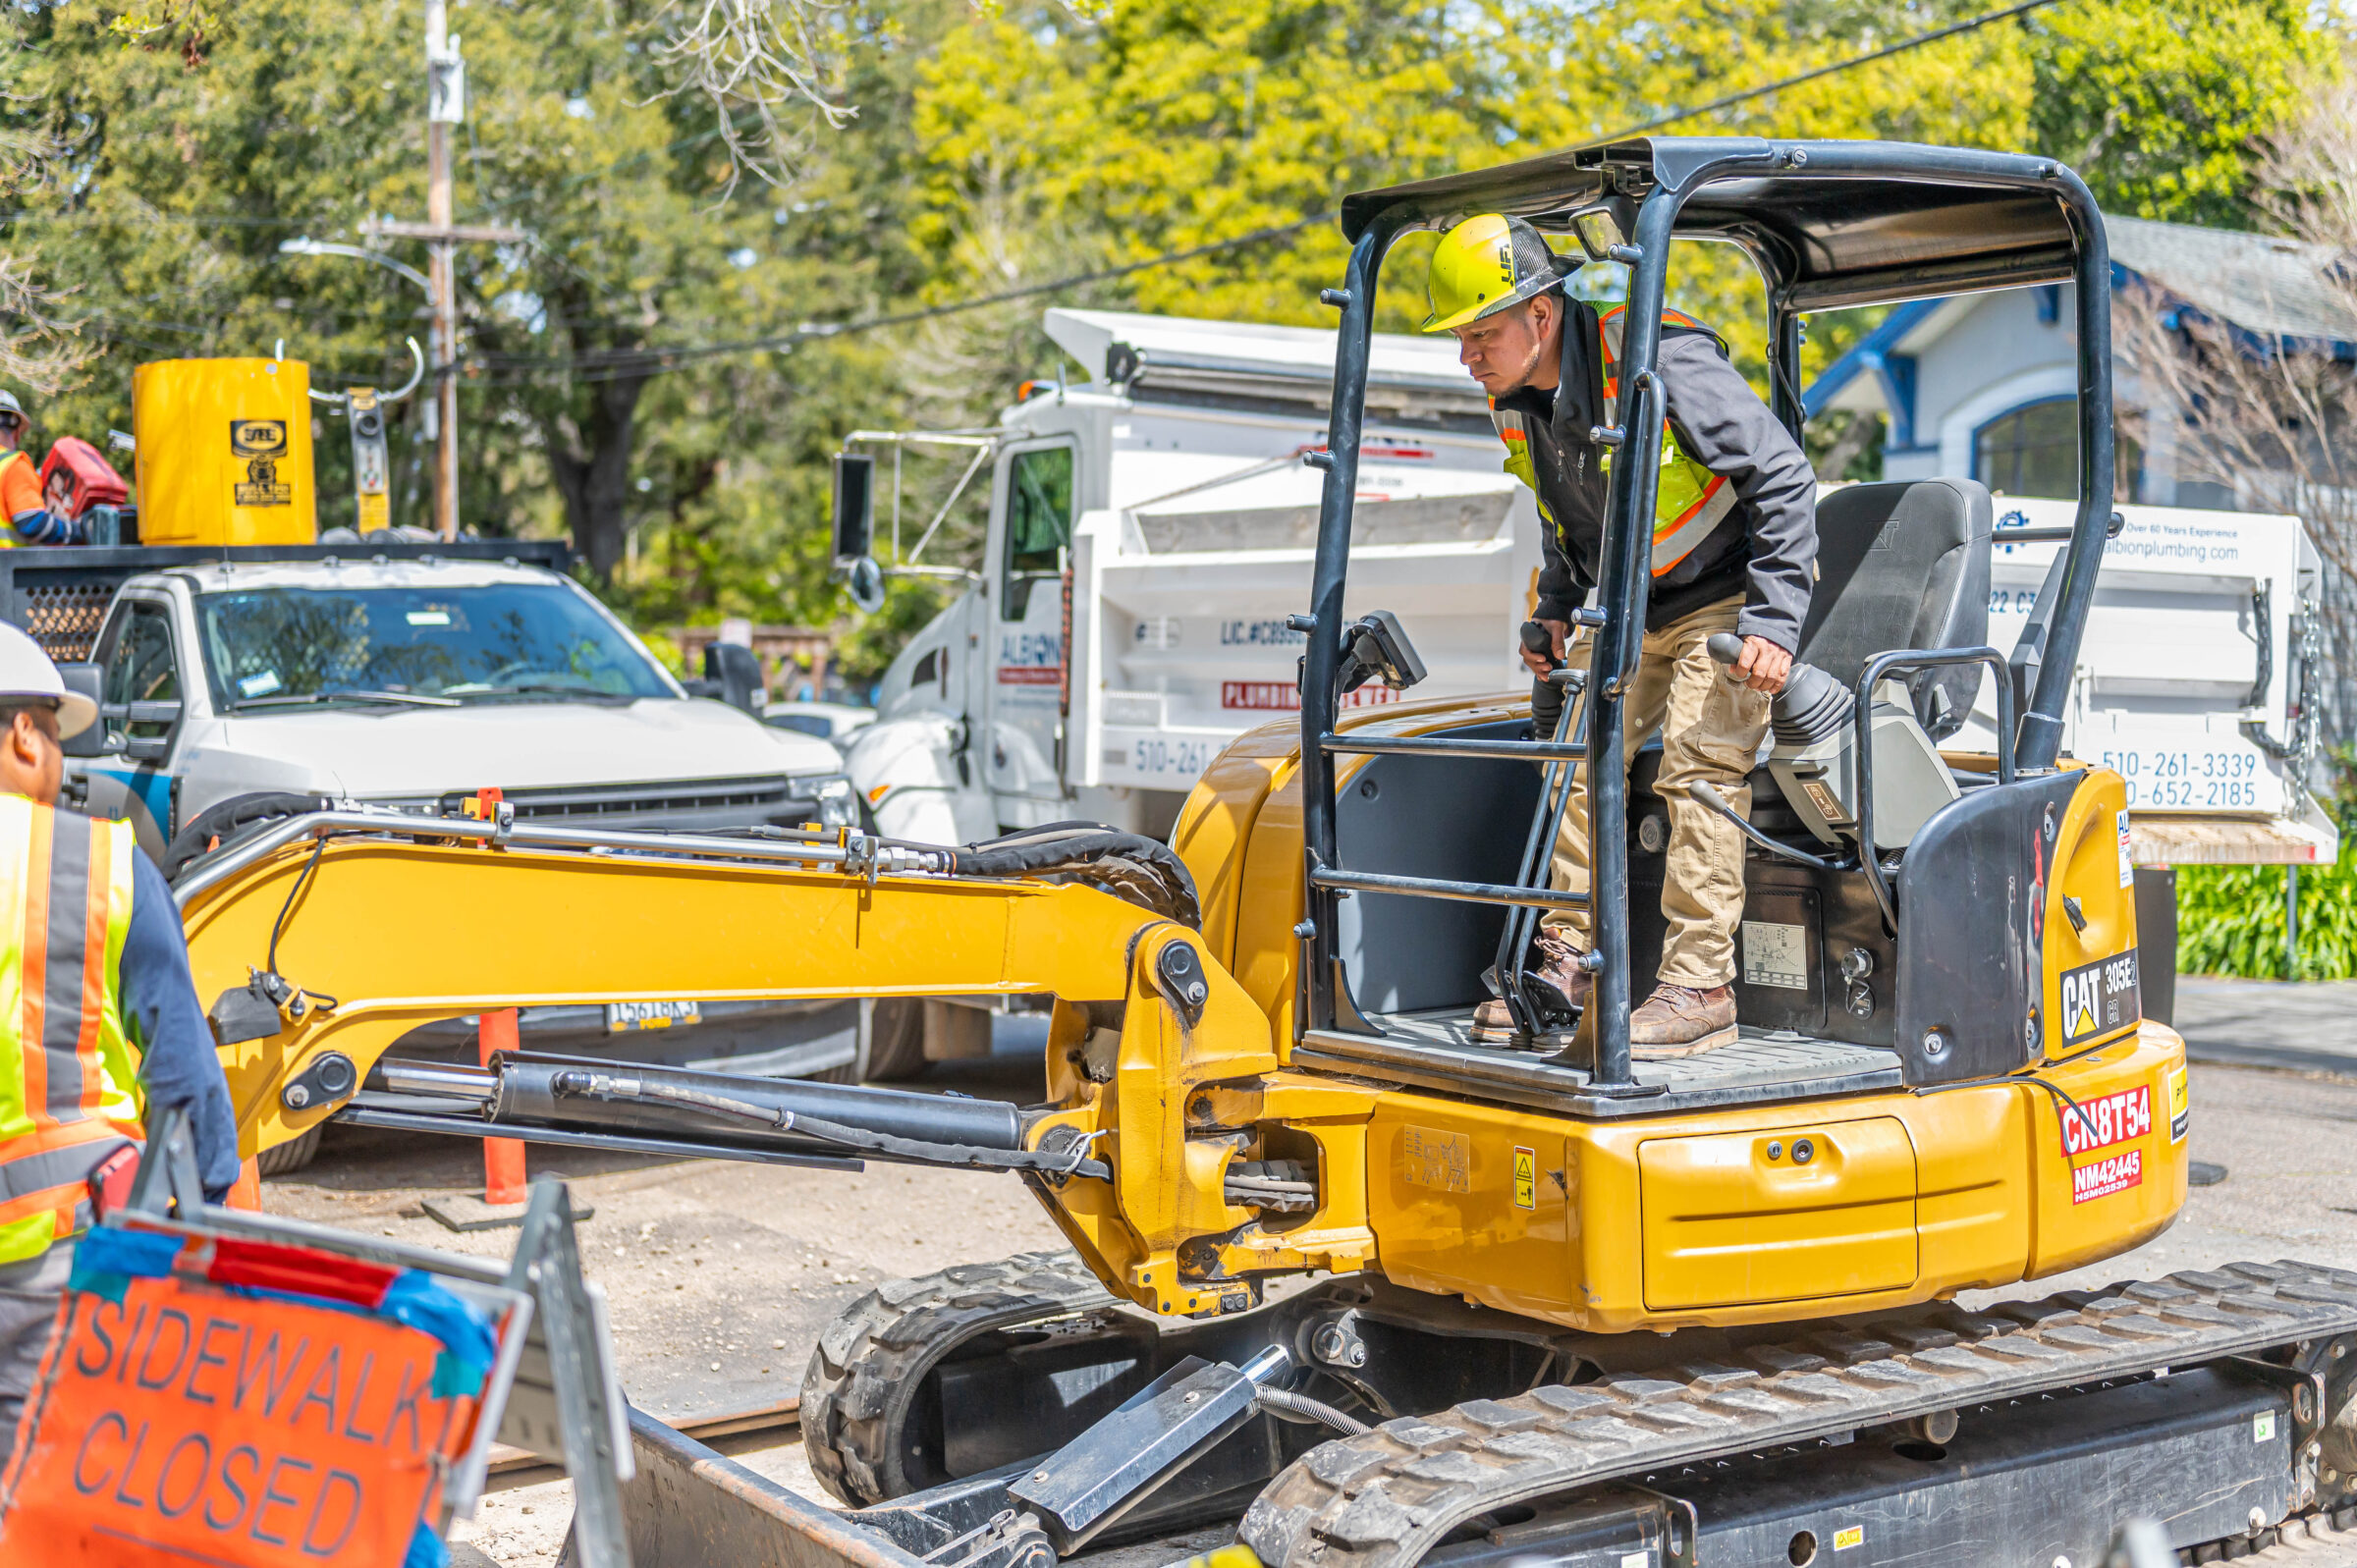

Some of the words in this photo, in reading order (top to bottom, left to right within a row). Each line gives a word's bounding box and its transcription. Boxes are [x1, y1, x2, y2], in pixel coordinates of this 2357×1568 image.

[2127, 522, 2147, 534] Over
[2150, 523, 2161, 534] 60
[2163, 524, 2187, 536] Years
[2189, 526, 2238, 538] Experience
[1225, 683, 1300, 708] PLUMBIN
[2103, 751, 2256, 778] 510-261-3339
[2125, 781, 2256, 806] 0-652-2185
[2062, 967, 2101, 1040] CAT
[2107, 999, 2119, 1025] CR
[2062, 1087, 2151, 1154] CN8T54
[2074, 1150, 2140, 1193] NM42445
[76, 1302, 432, 1453] SIDEWALK
[73, 1410, 363, 1558] CLOSED
